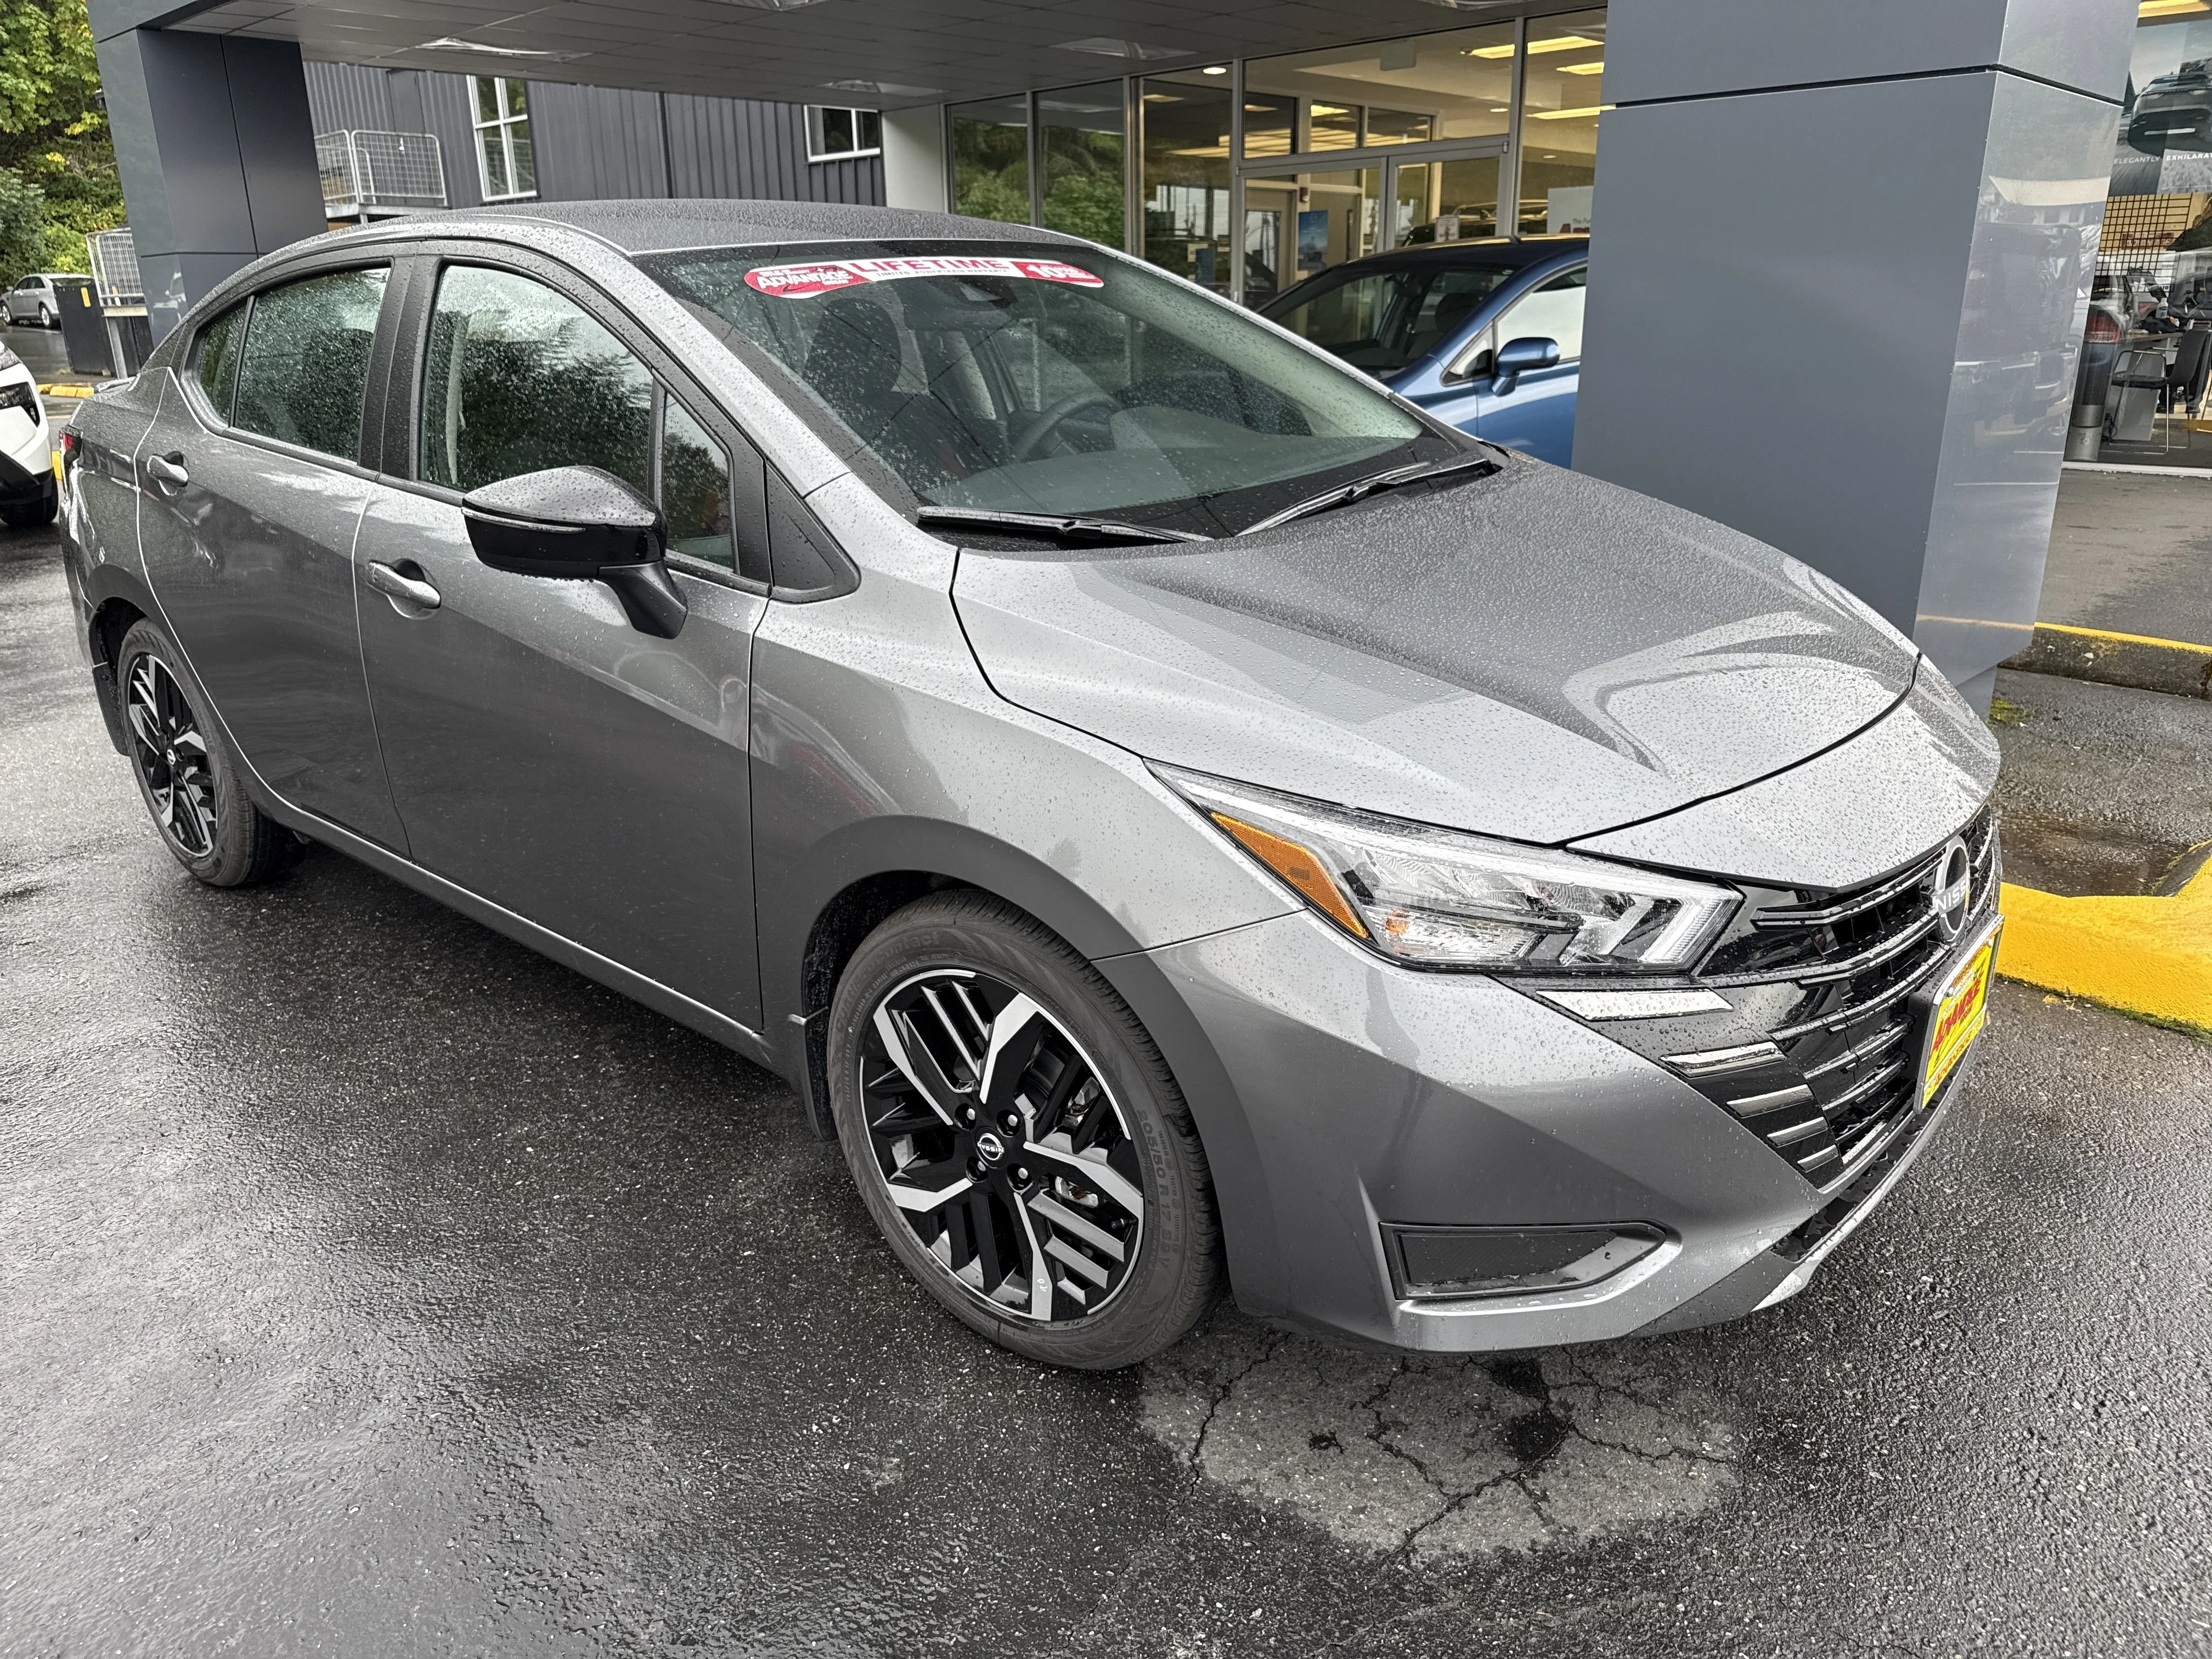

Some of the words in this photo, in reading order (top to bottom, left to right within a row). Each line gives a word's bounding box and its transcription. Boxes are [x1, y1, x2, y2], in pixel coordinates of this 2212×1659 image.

[2113, 156, 2161, 165] ELEGANTLY
[849, 259, 1011, 273] LIFETIME
[1026, 264, 1066, 279] 10
[756, 270, 854, 289] ADVANTAGE
[1136, 1108, 1167, 1179] 205/50
[1161, 1200, 1171, 1222] 17
